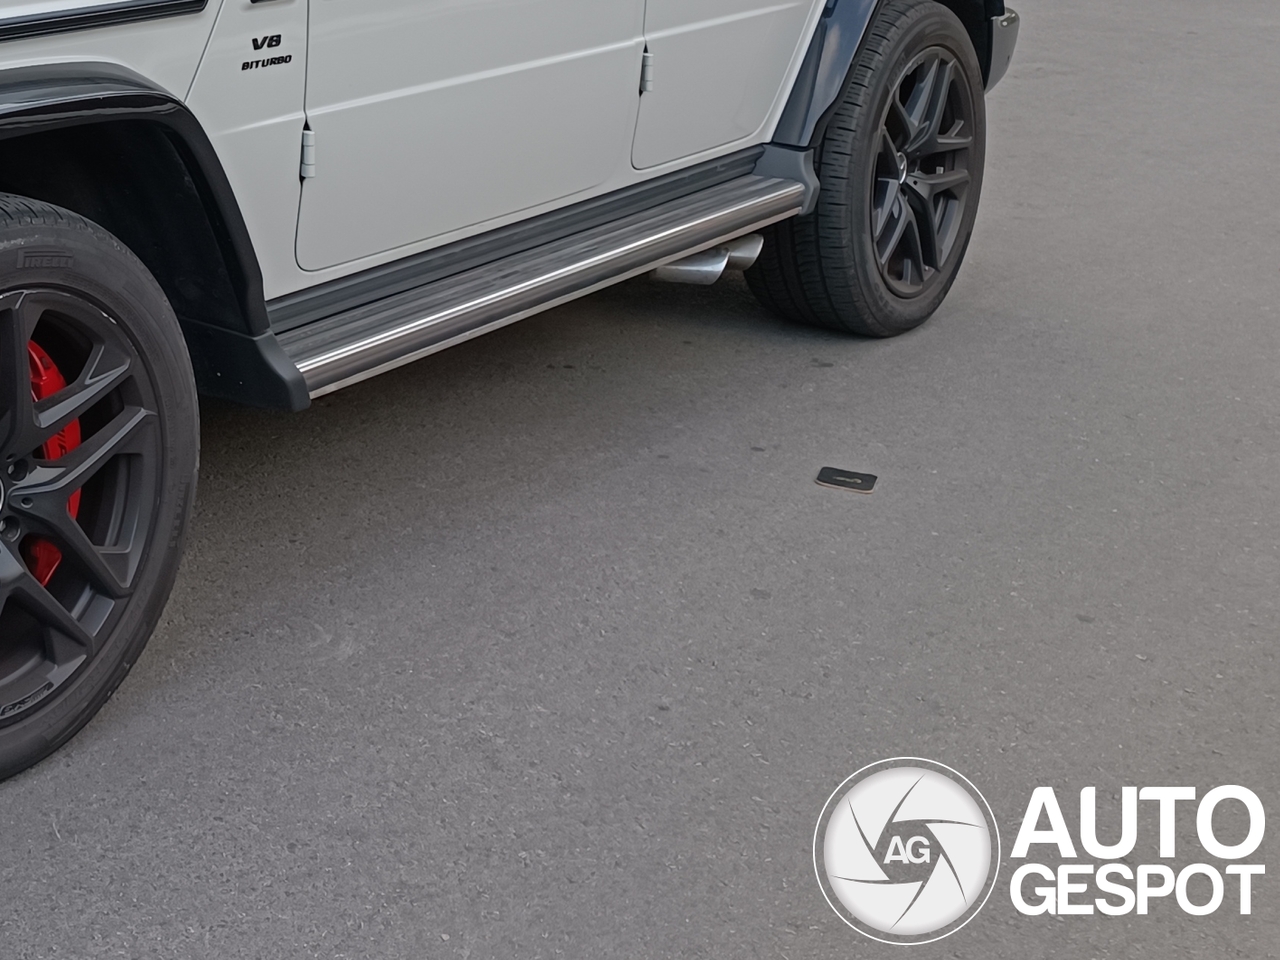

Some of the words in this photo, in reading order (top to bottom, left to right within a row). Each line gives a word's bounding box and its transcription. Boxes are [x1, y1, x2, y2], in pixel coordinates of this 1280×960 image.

[252, 34, 281, 50] V8
[241, 54, 292, 71] BITURBO
[16, 248, 75, 269] PIRELLI
